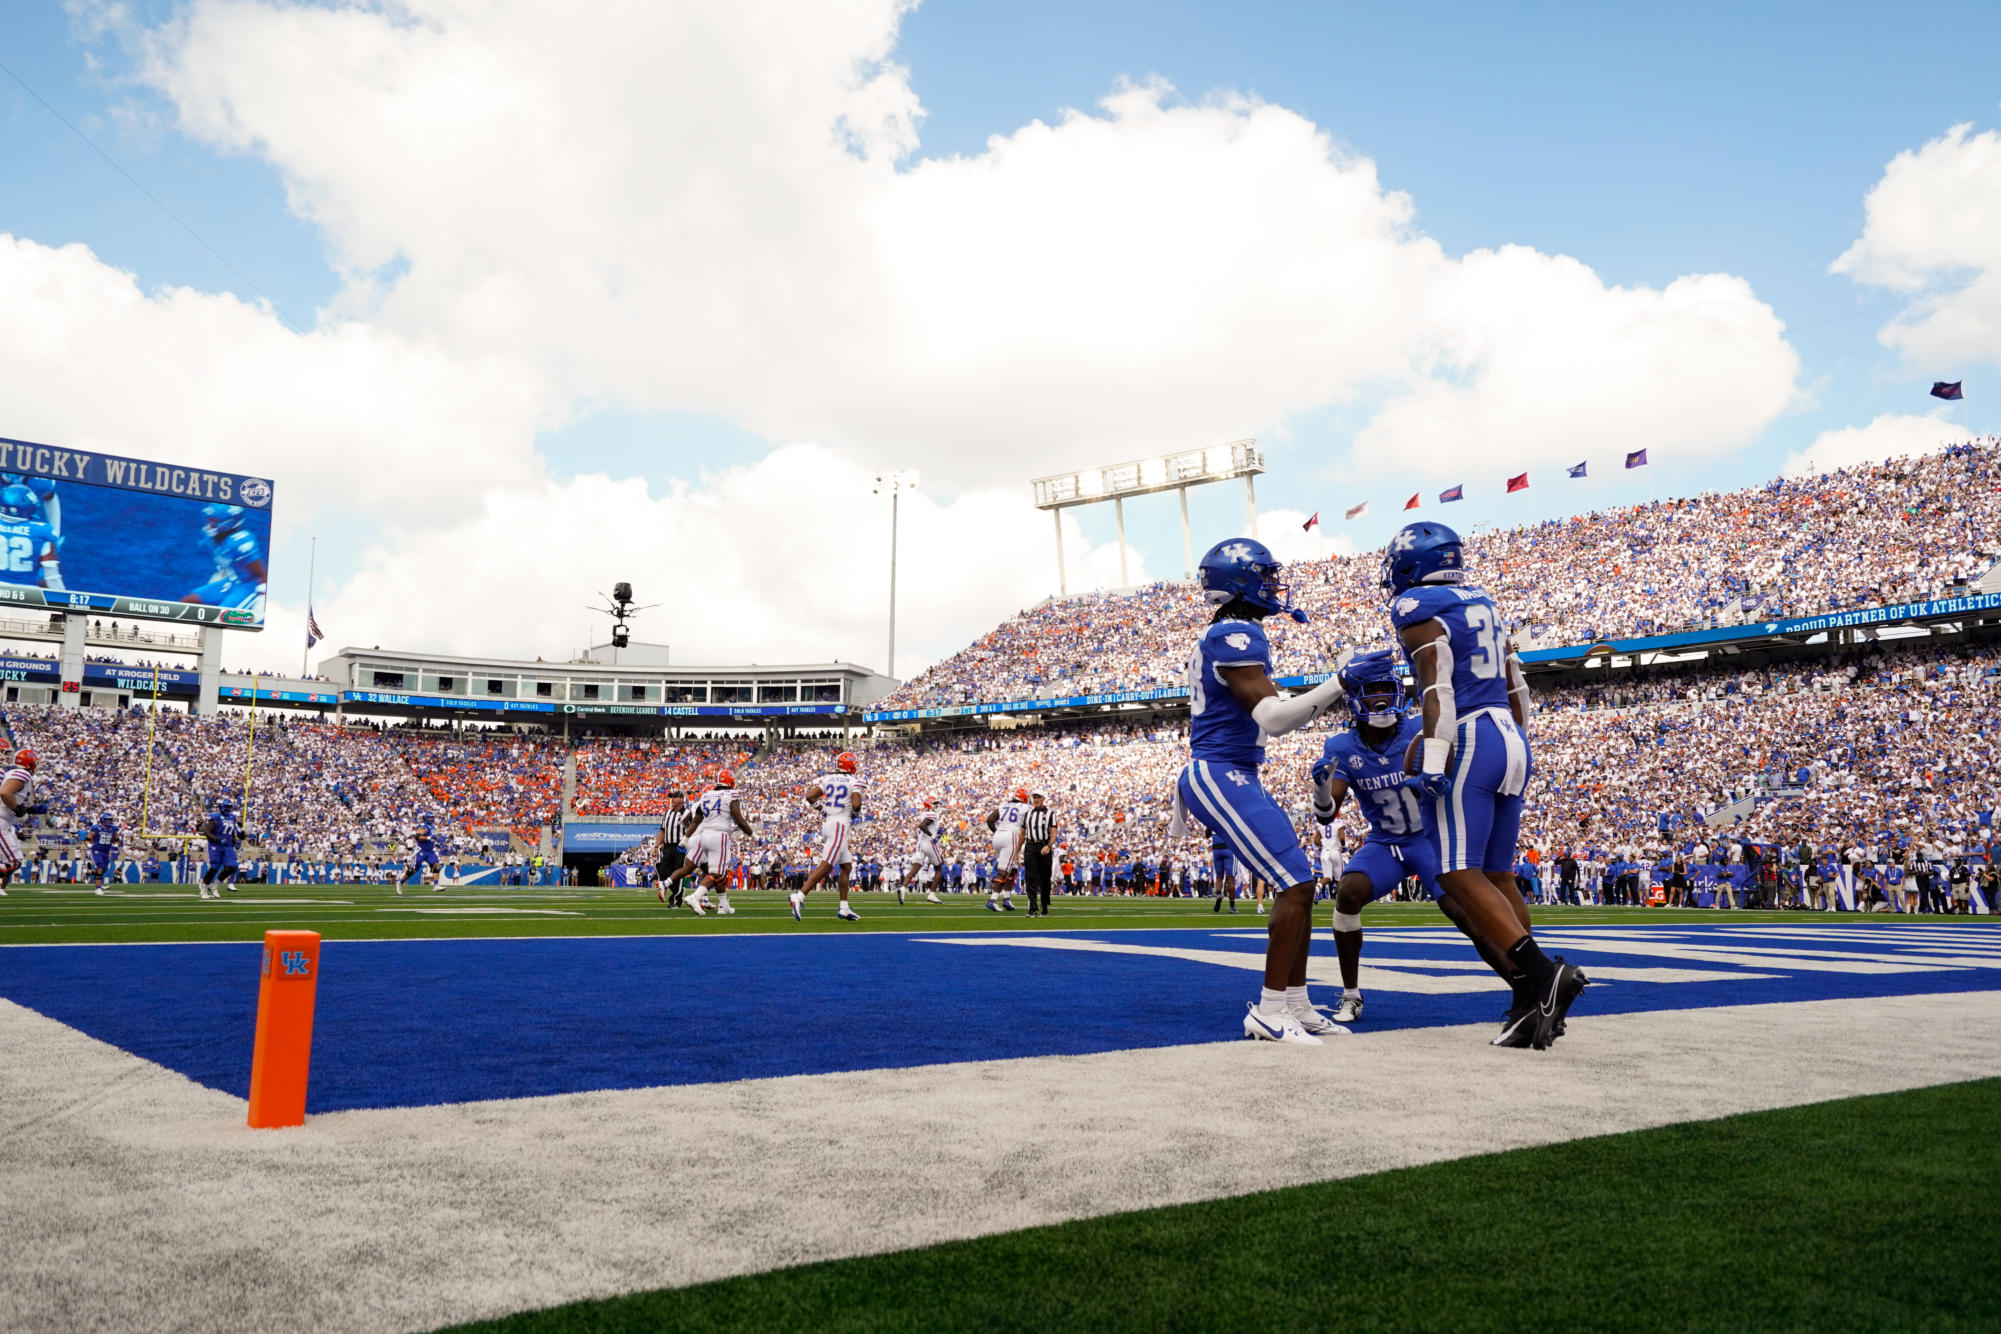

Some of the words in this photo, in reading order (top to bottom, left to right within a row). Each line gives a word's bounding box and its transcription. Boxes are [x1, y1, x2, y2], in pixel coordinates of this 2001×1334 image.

[105, 459, 233, 500] WILDCATS
[1221, 543, 1254, 564] UK
[19, 591, 25, 600] 5
[70, 594, 90, 605] 6:17
[129, 602, 147, 612] BALL
[149, 604, 158, 613] ON
[160, 605, 170, 614] 30
[198, 608, 205, 620] 0
[1829, 610, 1886, 627] PARTNER
[1890, 606, 1906, 619] OF
[1910, 604, 1929, 616] UK
[6, 661, 52, 670] GROUNDS
[105, 668, 119, 676] AT
[121, 670, 154, 679] KROGER
[157, 673, 180, 681] FIELD
[1304, 674, 1330, 684] PROUD
[64, 681, 80, 692] 25
[117, 679, 168, 691] WILDCATS
[368, 693, 376, 702] 32
[378, 694, 410, 704] WALLACE
[504, 702, 508, 710] 0
[1087, 694, 1112, 704] DINE-IN
[1116, 691, 1154, 702] CARRY-OUT
[1158, 688, 1180, 698] LARGE
[610, 706, 635, 714] DEFENSIVE
[664, 707, 672, 715] 14
[672, 707, 699, 716] CASTELL
[826, 784, 848, 808] 22
[703, 799, 722, 818] 54
[1002, 807, 1019, 822] 76
[1372, 787, 1423, 834] 31
[222, 822, 235, 835] 77
[1325, 824, 1332, 839] 8
[1655, 890, 1664, 900] G
[281, 951, 310, 975] UK
